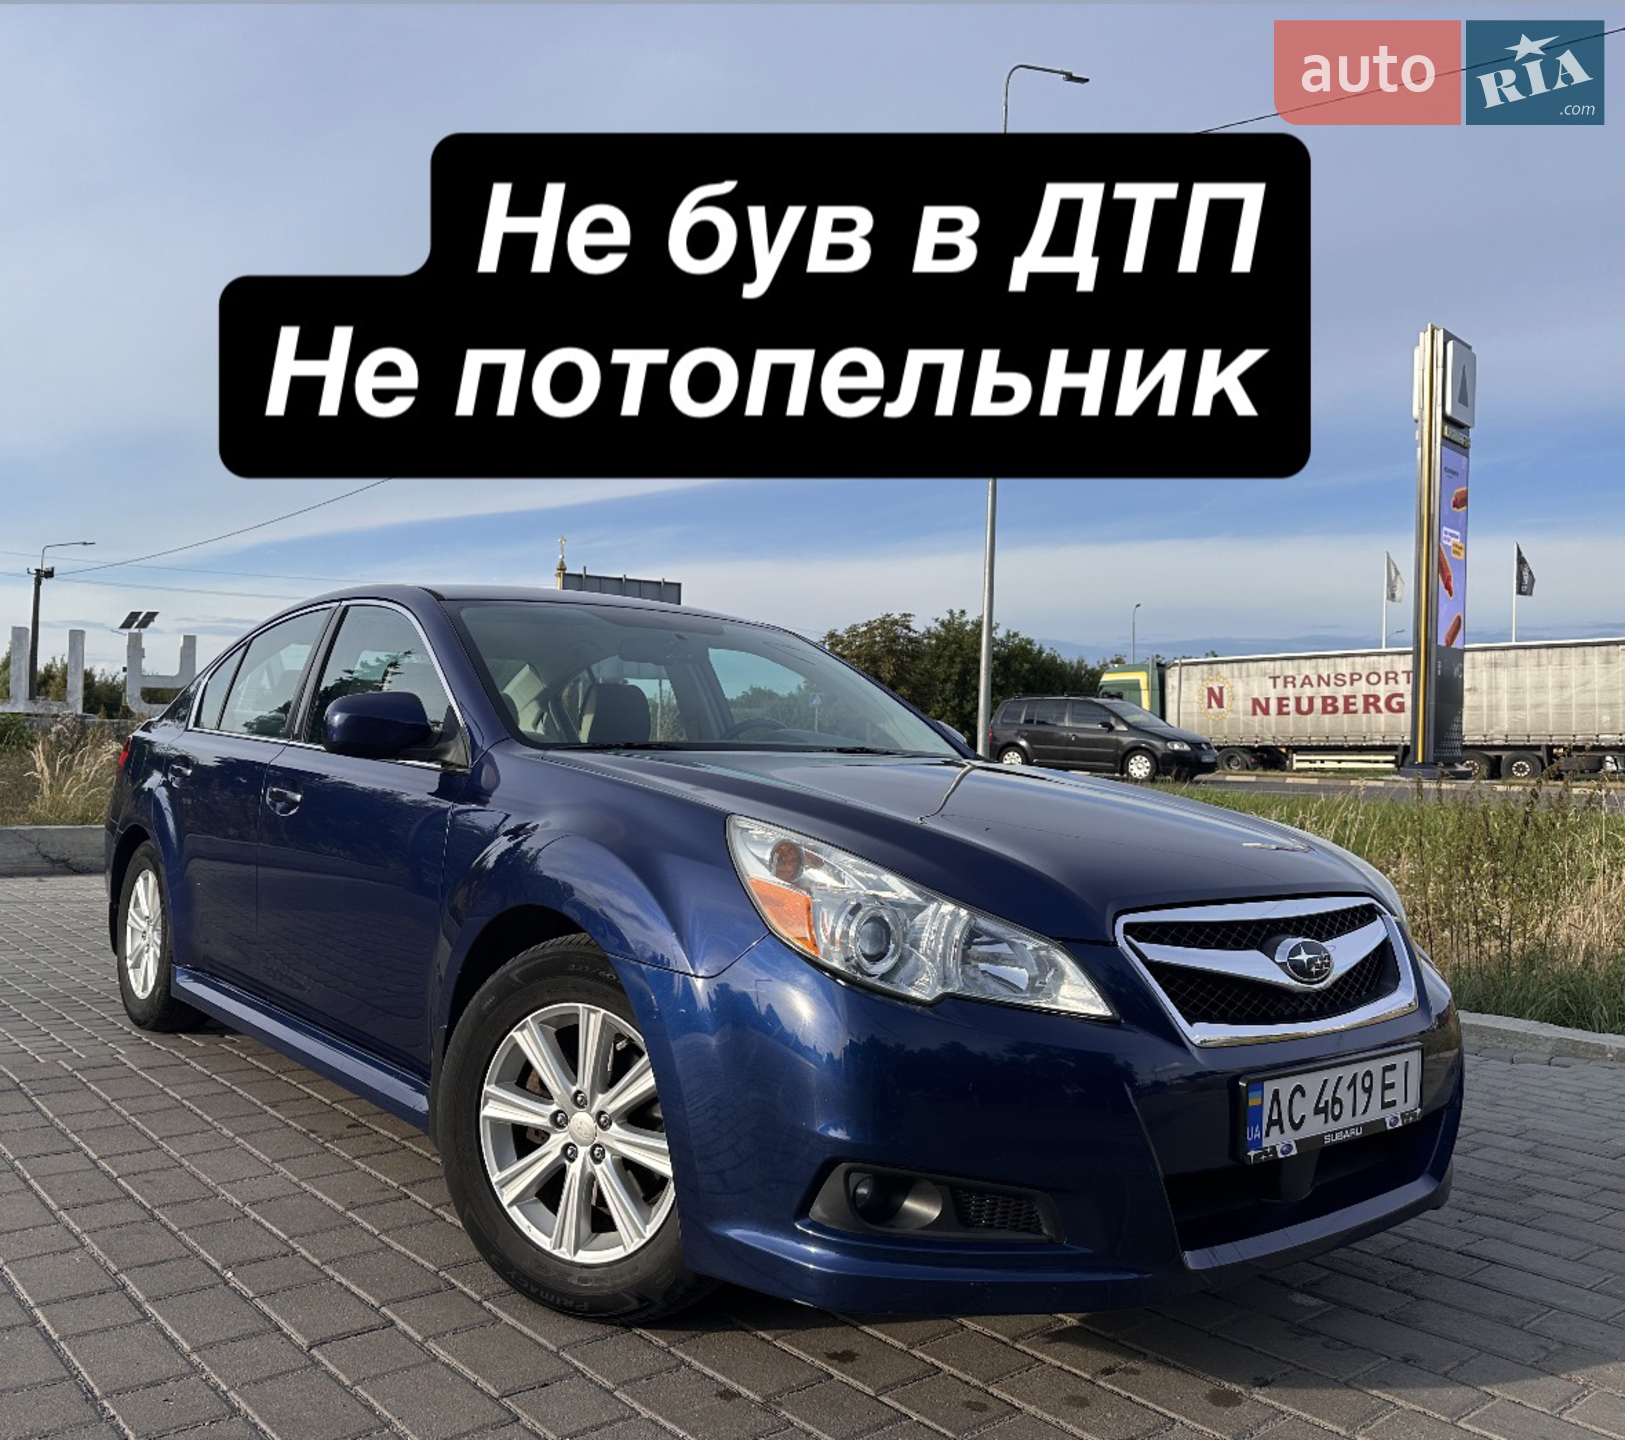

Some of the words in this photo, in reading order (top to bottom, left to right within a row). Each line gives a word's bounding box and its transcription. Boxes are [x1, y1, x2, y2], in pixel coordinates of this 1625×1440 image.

[1269, 670, 1412, 689] TRANSPORT
[1206, 686, 1225, 709] N
[1246, 1126, 1261, 1141] UA
[1323, 1126, 1363, 1145] SUBARU
